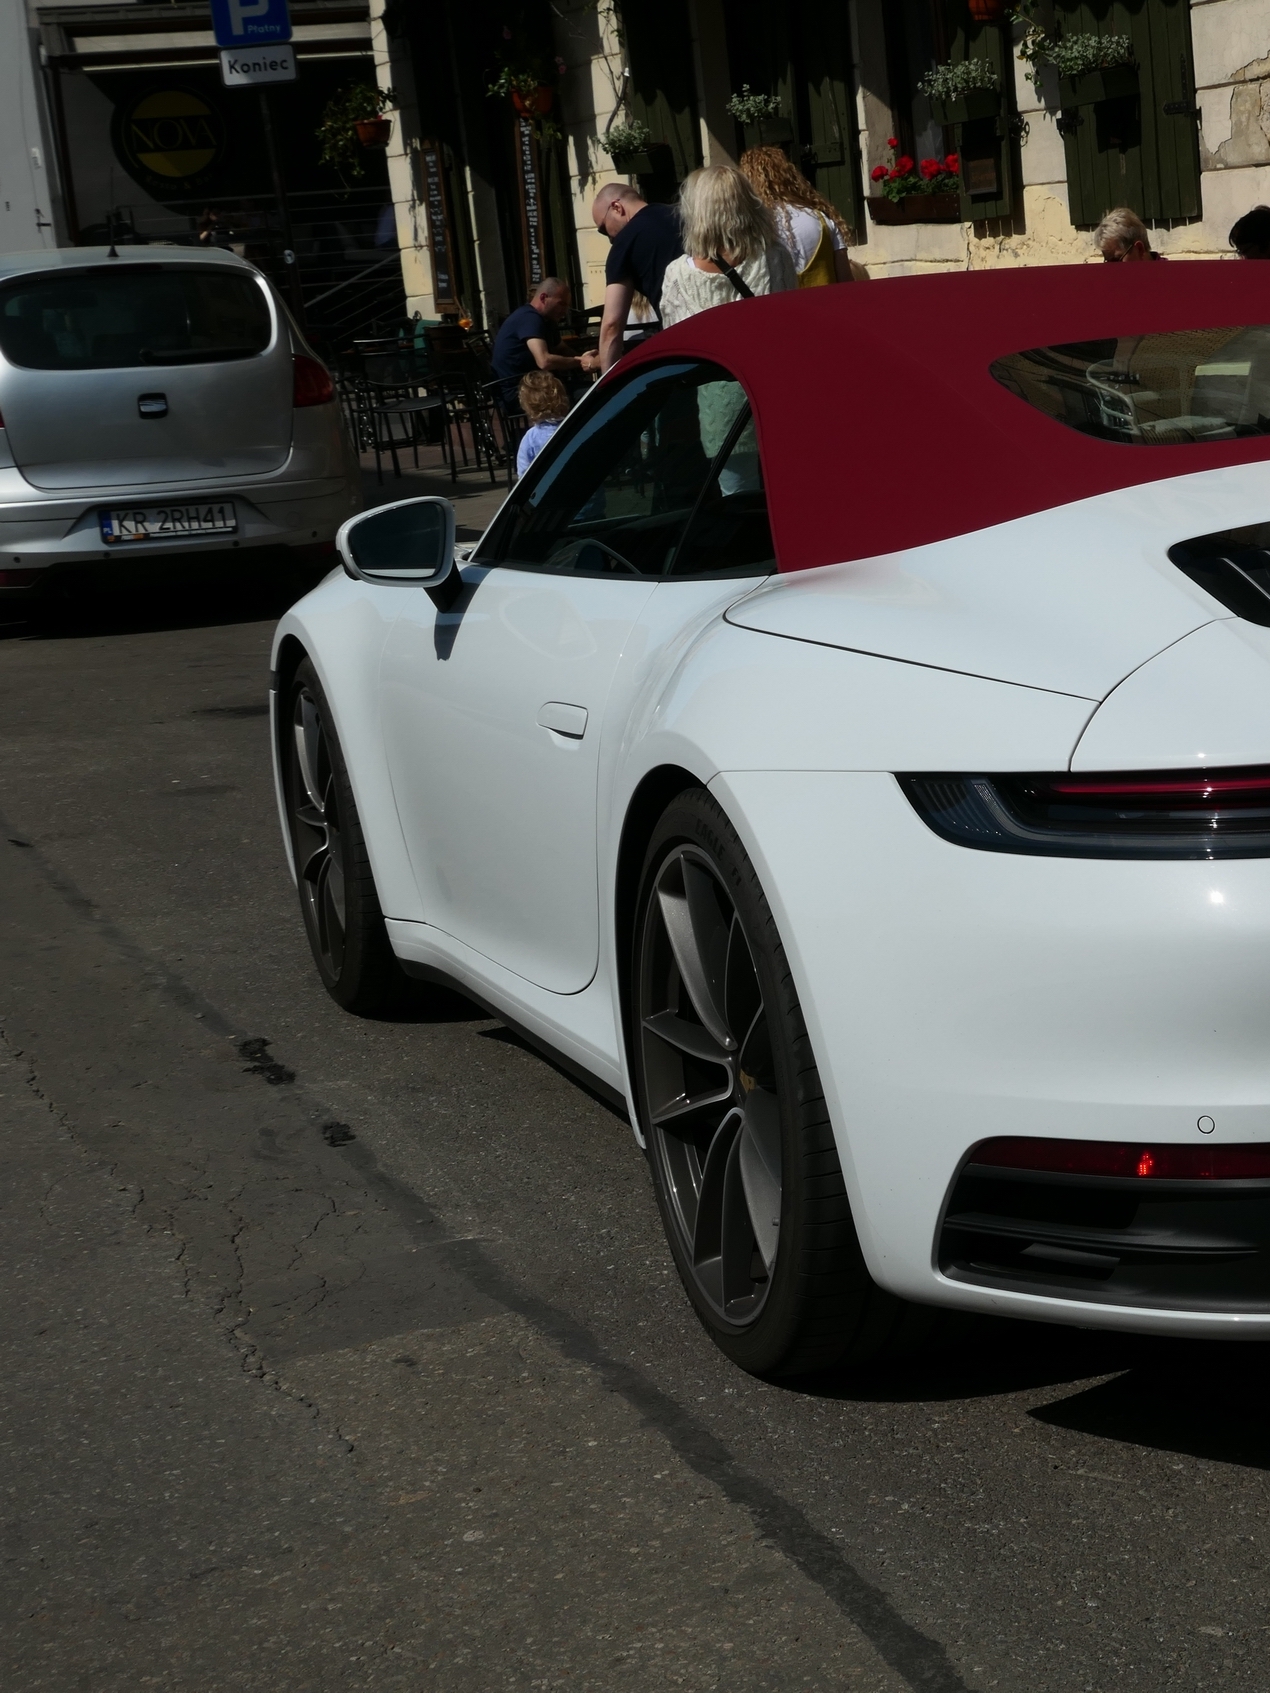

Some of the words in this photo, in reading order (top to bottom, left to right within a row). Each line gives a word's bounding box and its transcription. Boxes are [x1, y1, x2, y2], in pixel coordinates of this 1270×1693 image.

[227, 0, 269, 36] P
[228, 56, 289, 74] Koniec
[128, 115, 217, 151] NOVA
[116, 511, 149, 534] KR
[156, 505, 227, 531] 2RH41
